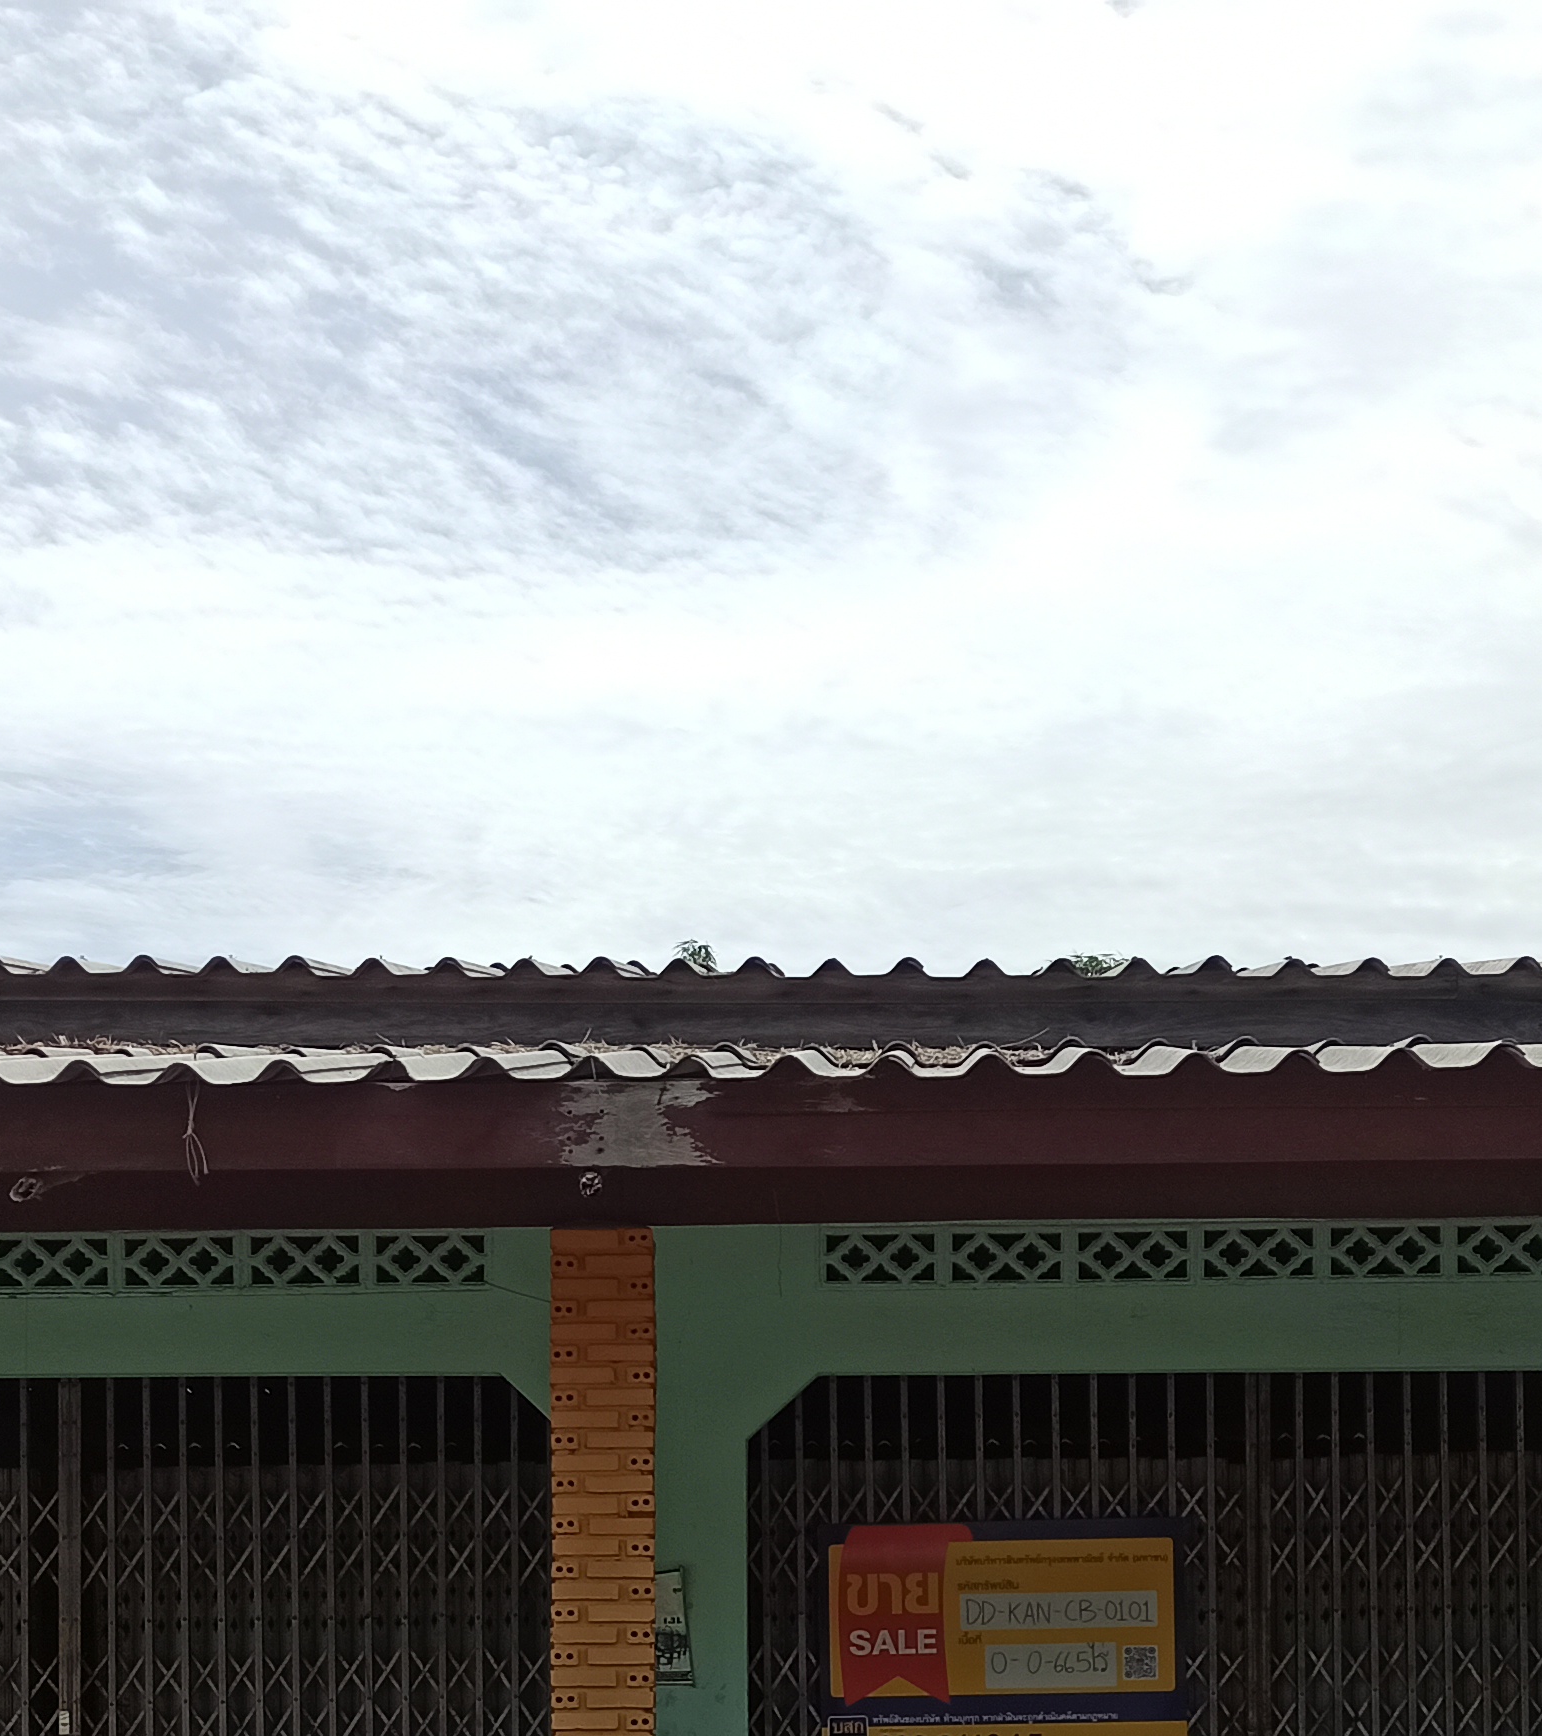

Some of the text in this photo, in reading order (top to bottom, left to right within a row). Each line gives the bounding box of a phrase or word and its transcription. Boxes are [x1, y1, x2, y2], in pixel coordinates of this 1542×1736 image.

[846, 1571, 939, 1617] ขาย
[965, 1598, 1154, 1626] DD-KAN-CB-0101
[849, 1629, 938, 1656] SALE
[832, 1720, 864, 1734] บสก
